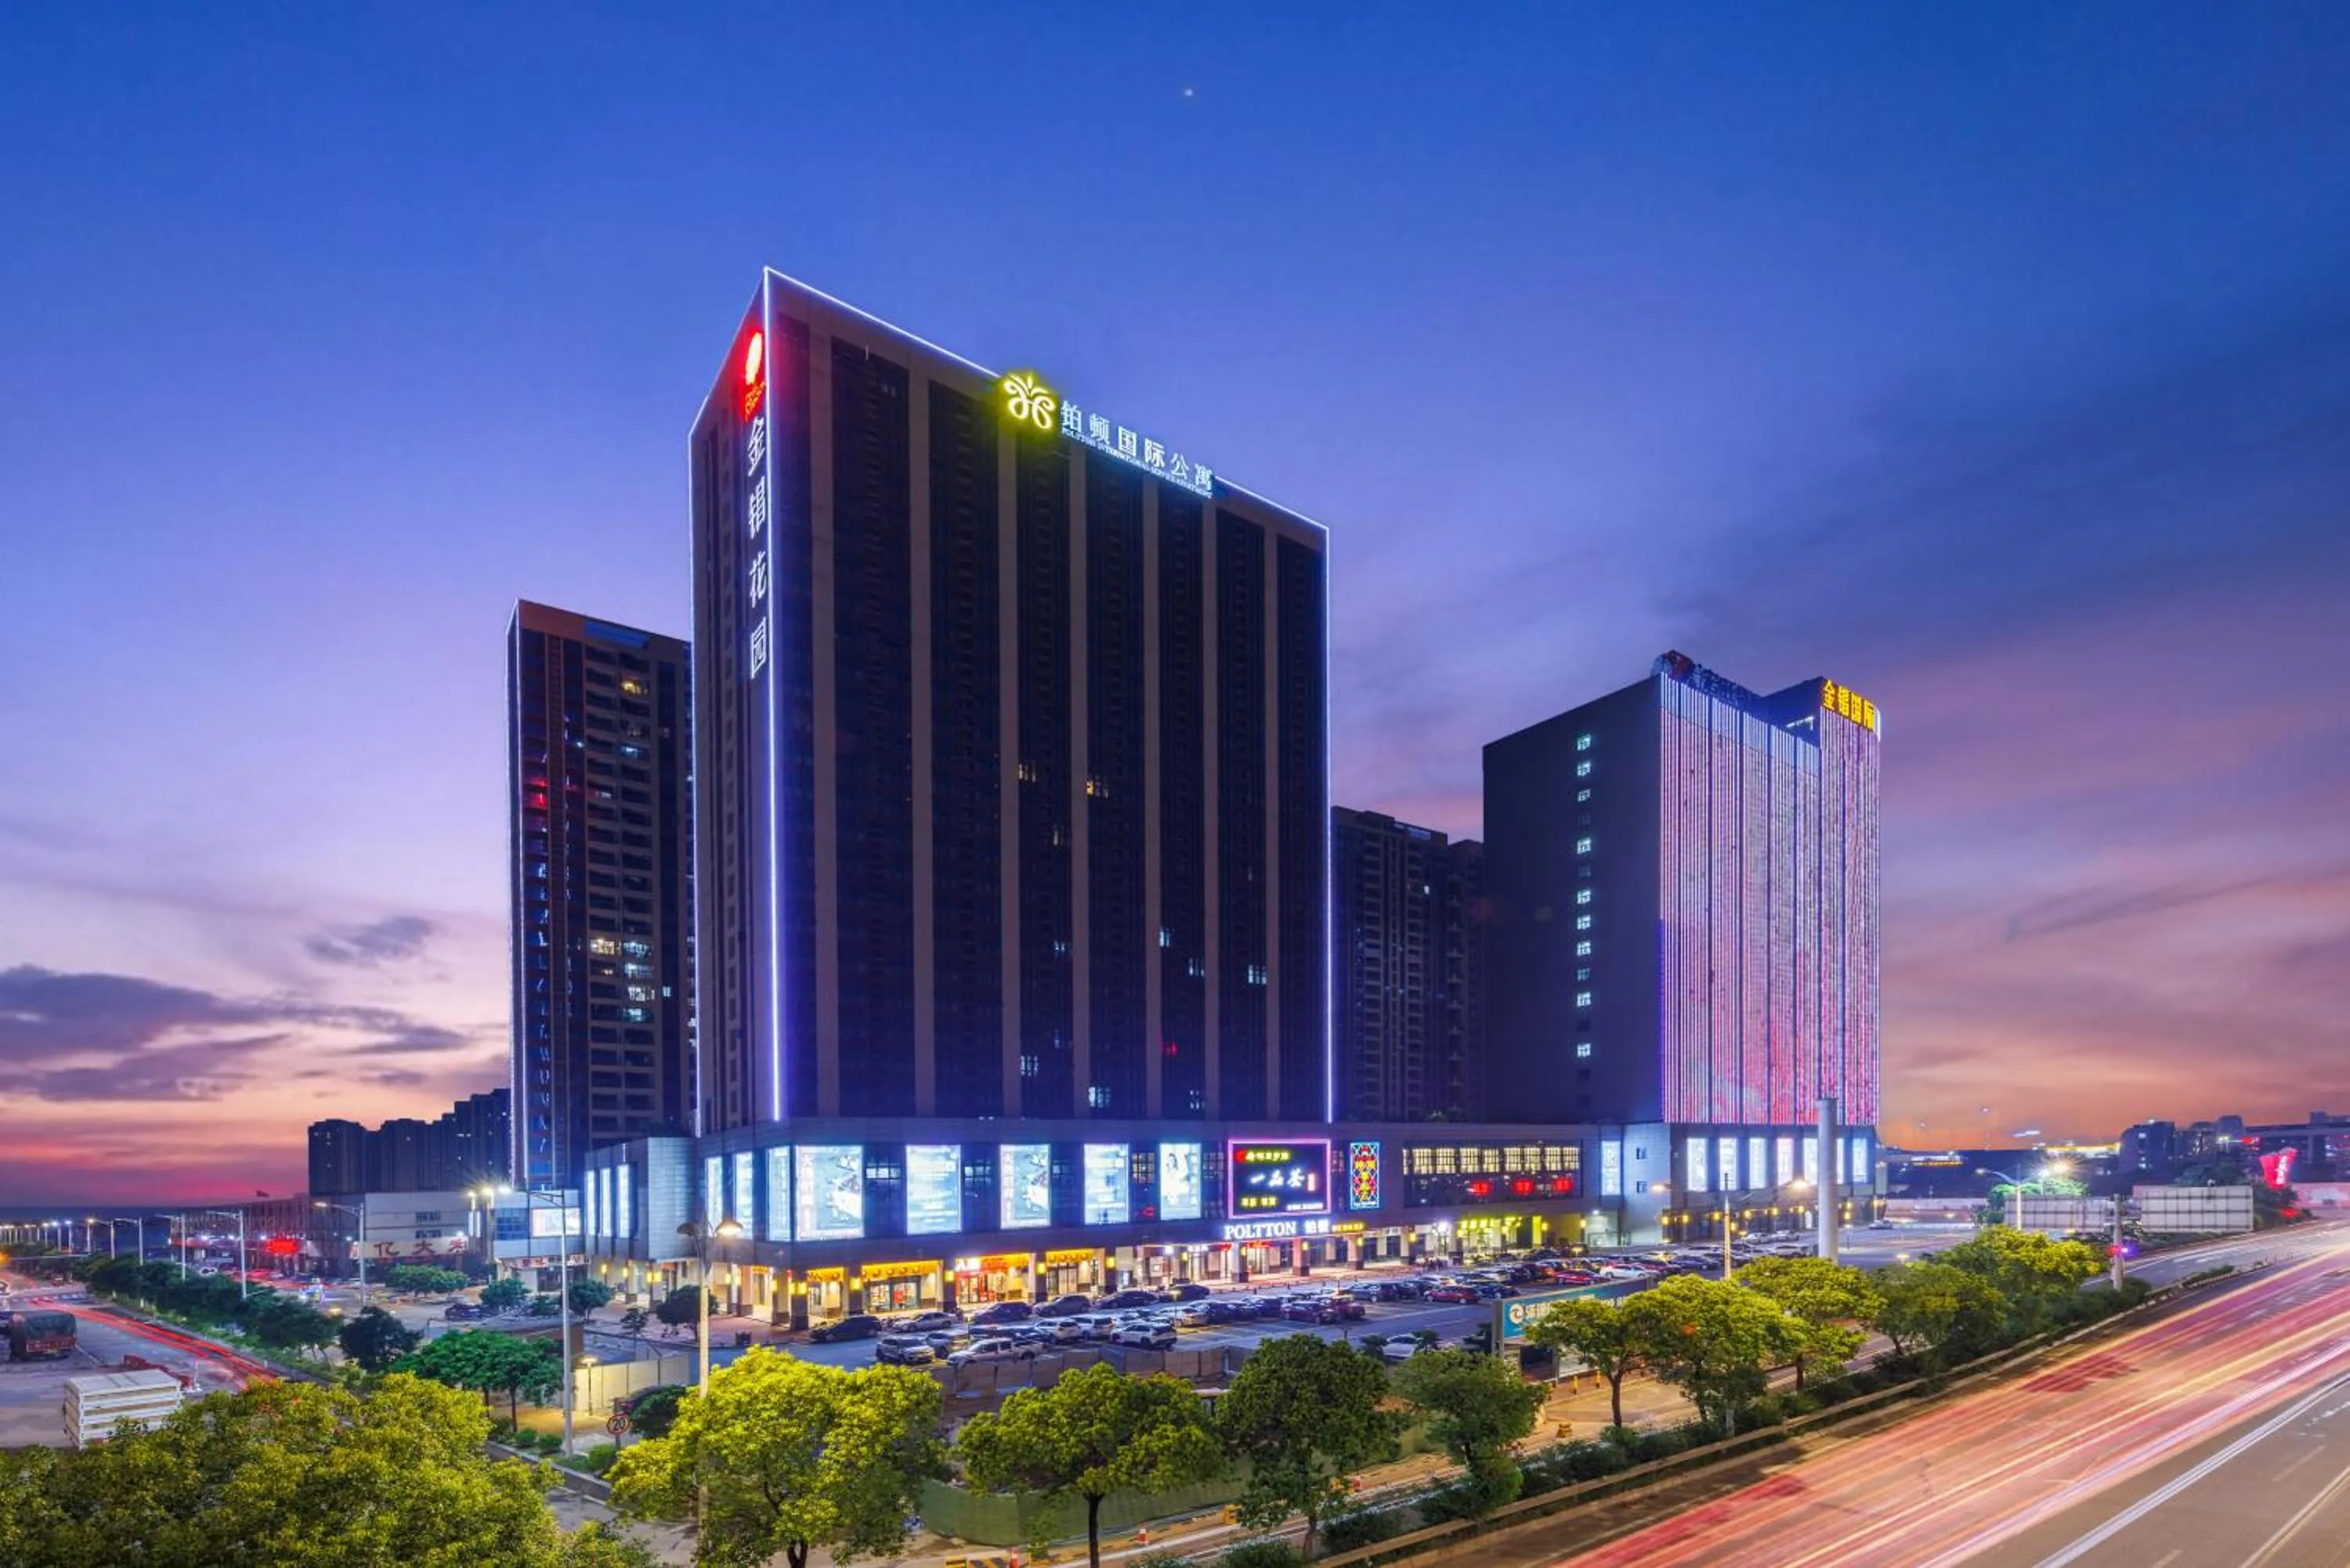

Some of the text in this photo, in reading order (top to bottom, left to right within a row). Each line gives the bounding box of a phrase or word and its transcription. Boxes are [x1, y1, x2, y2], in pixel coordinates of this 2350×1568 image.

[1061, 399, 1213, 491] 铂顿国际公寓
[1224, 1221, 1296, 1240] POLTTON
